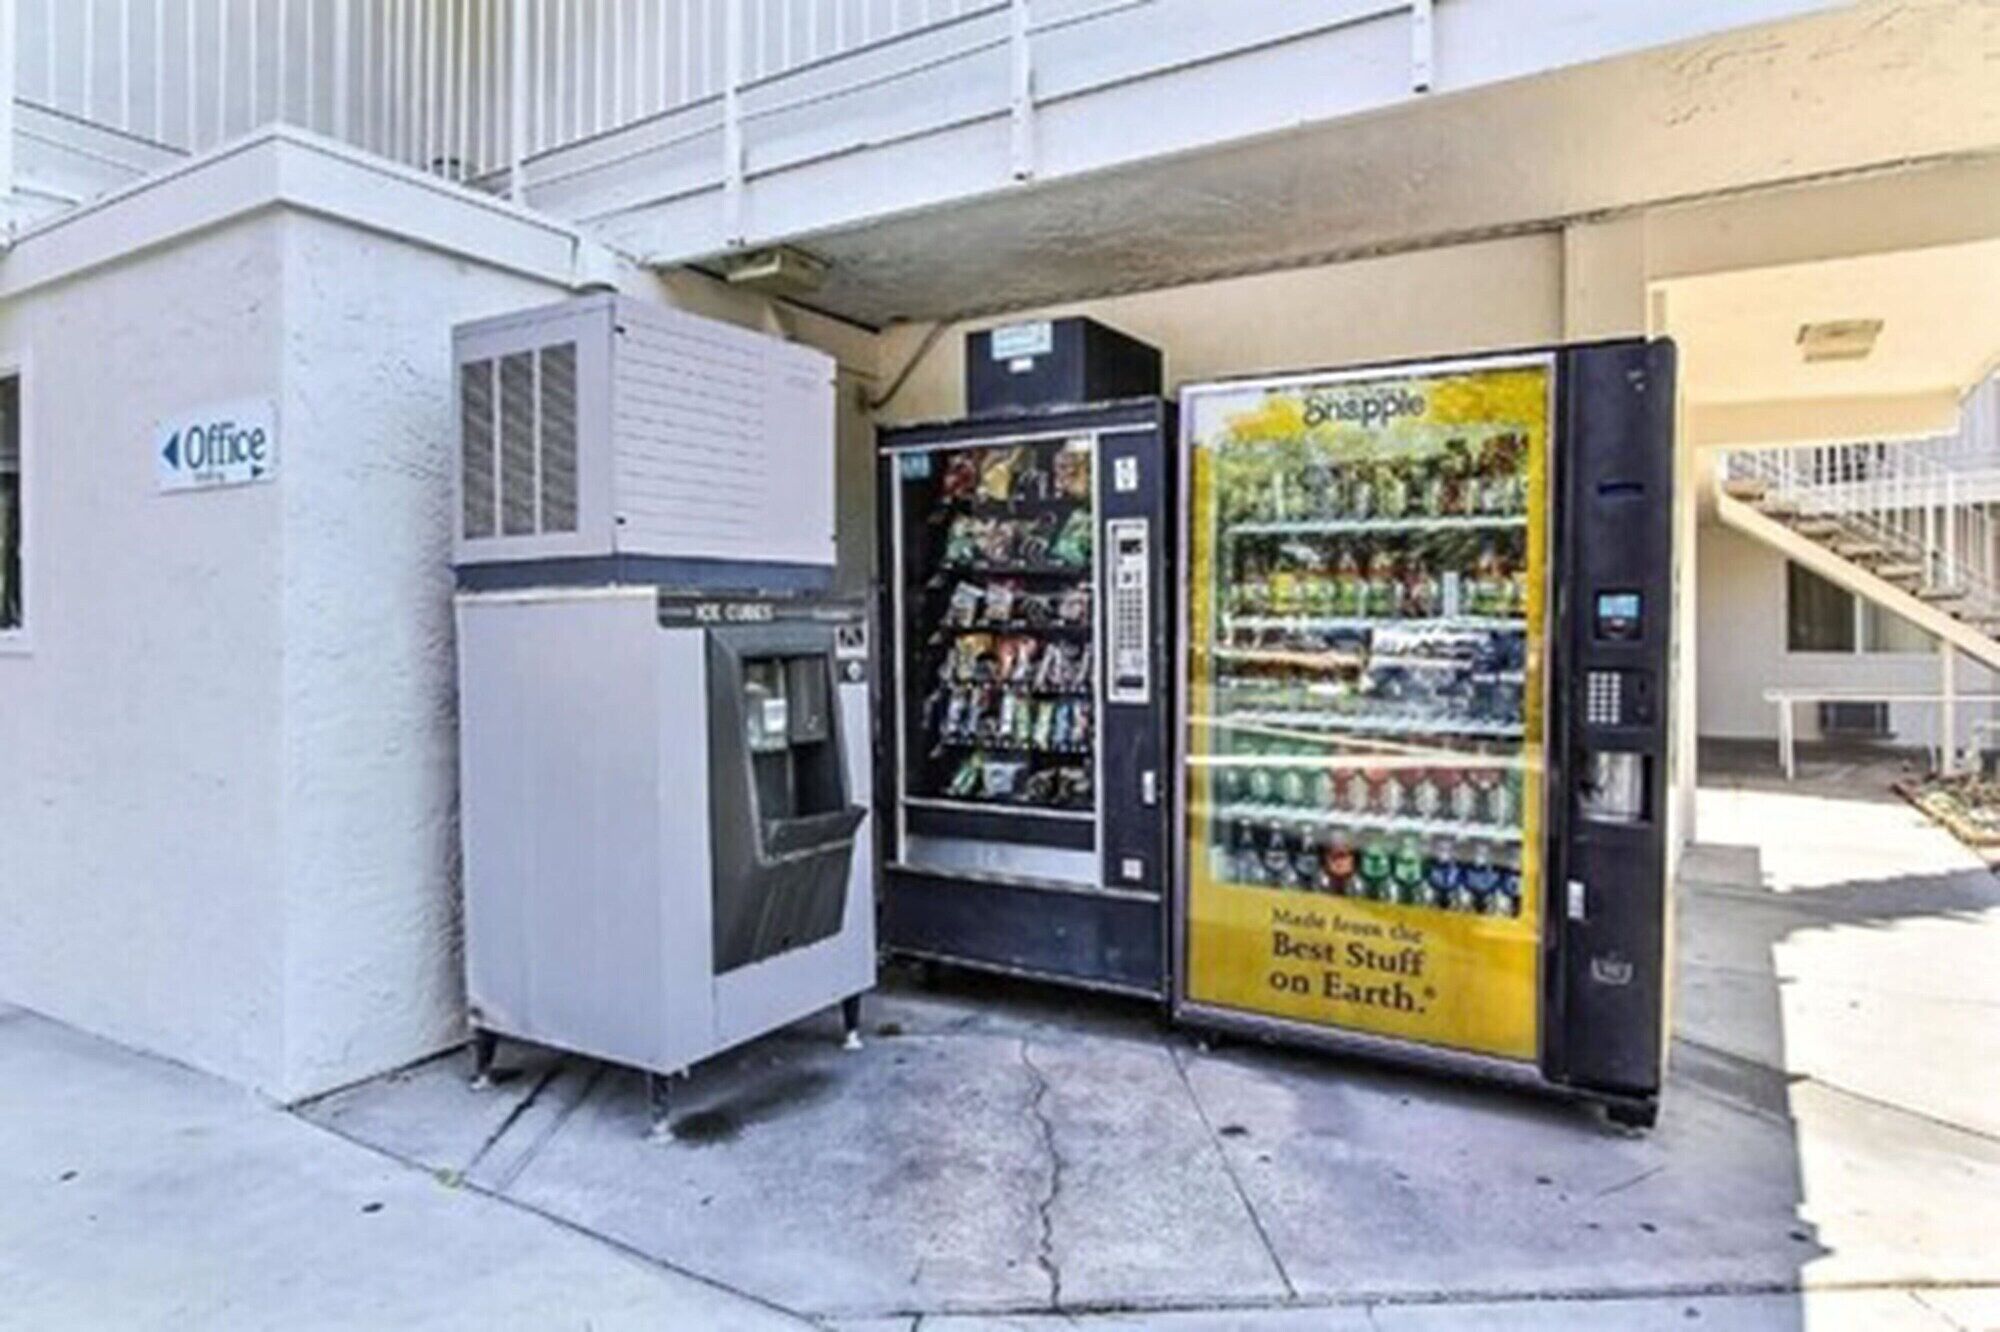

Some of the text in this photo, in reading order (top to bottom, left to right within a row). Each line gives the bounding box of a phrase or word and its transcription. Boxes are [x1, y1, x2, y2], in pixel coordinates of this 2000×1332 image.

[1303, 389, 1425, 427] Snapple
[184, 421, 266, 470] Office
[696, 602, 775, 621] ICE CUBES
[1272, 908, 1423, 944] Made from the
[1272, 930, 1424, 977] Best Stuff
[1269, 970, 1310, 995] on
